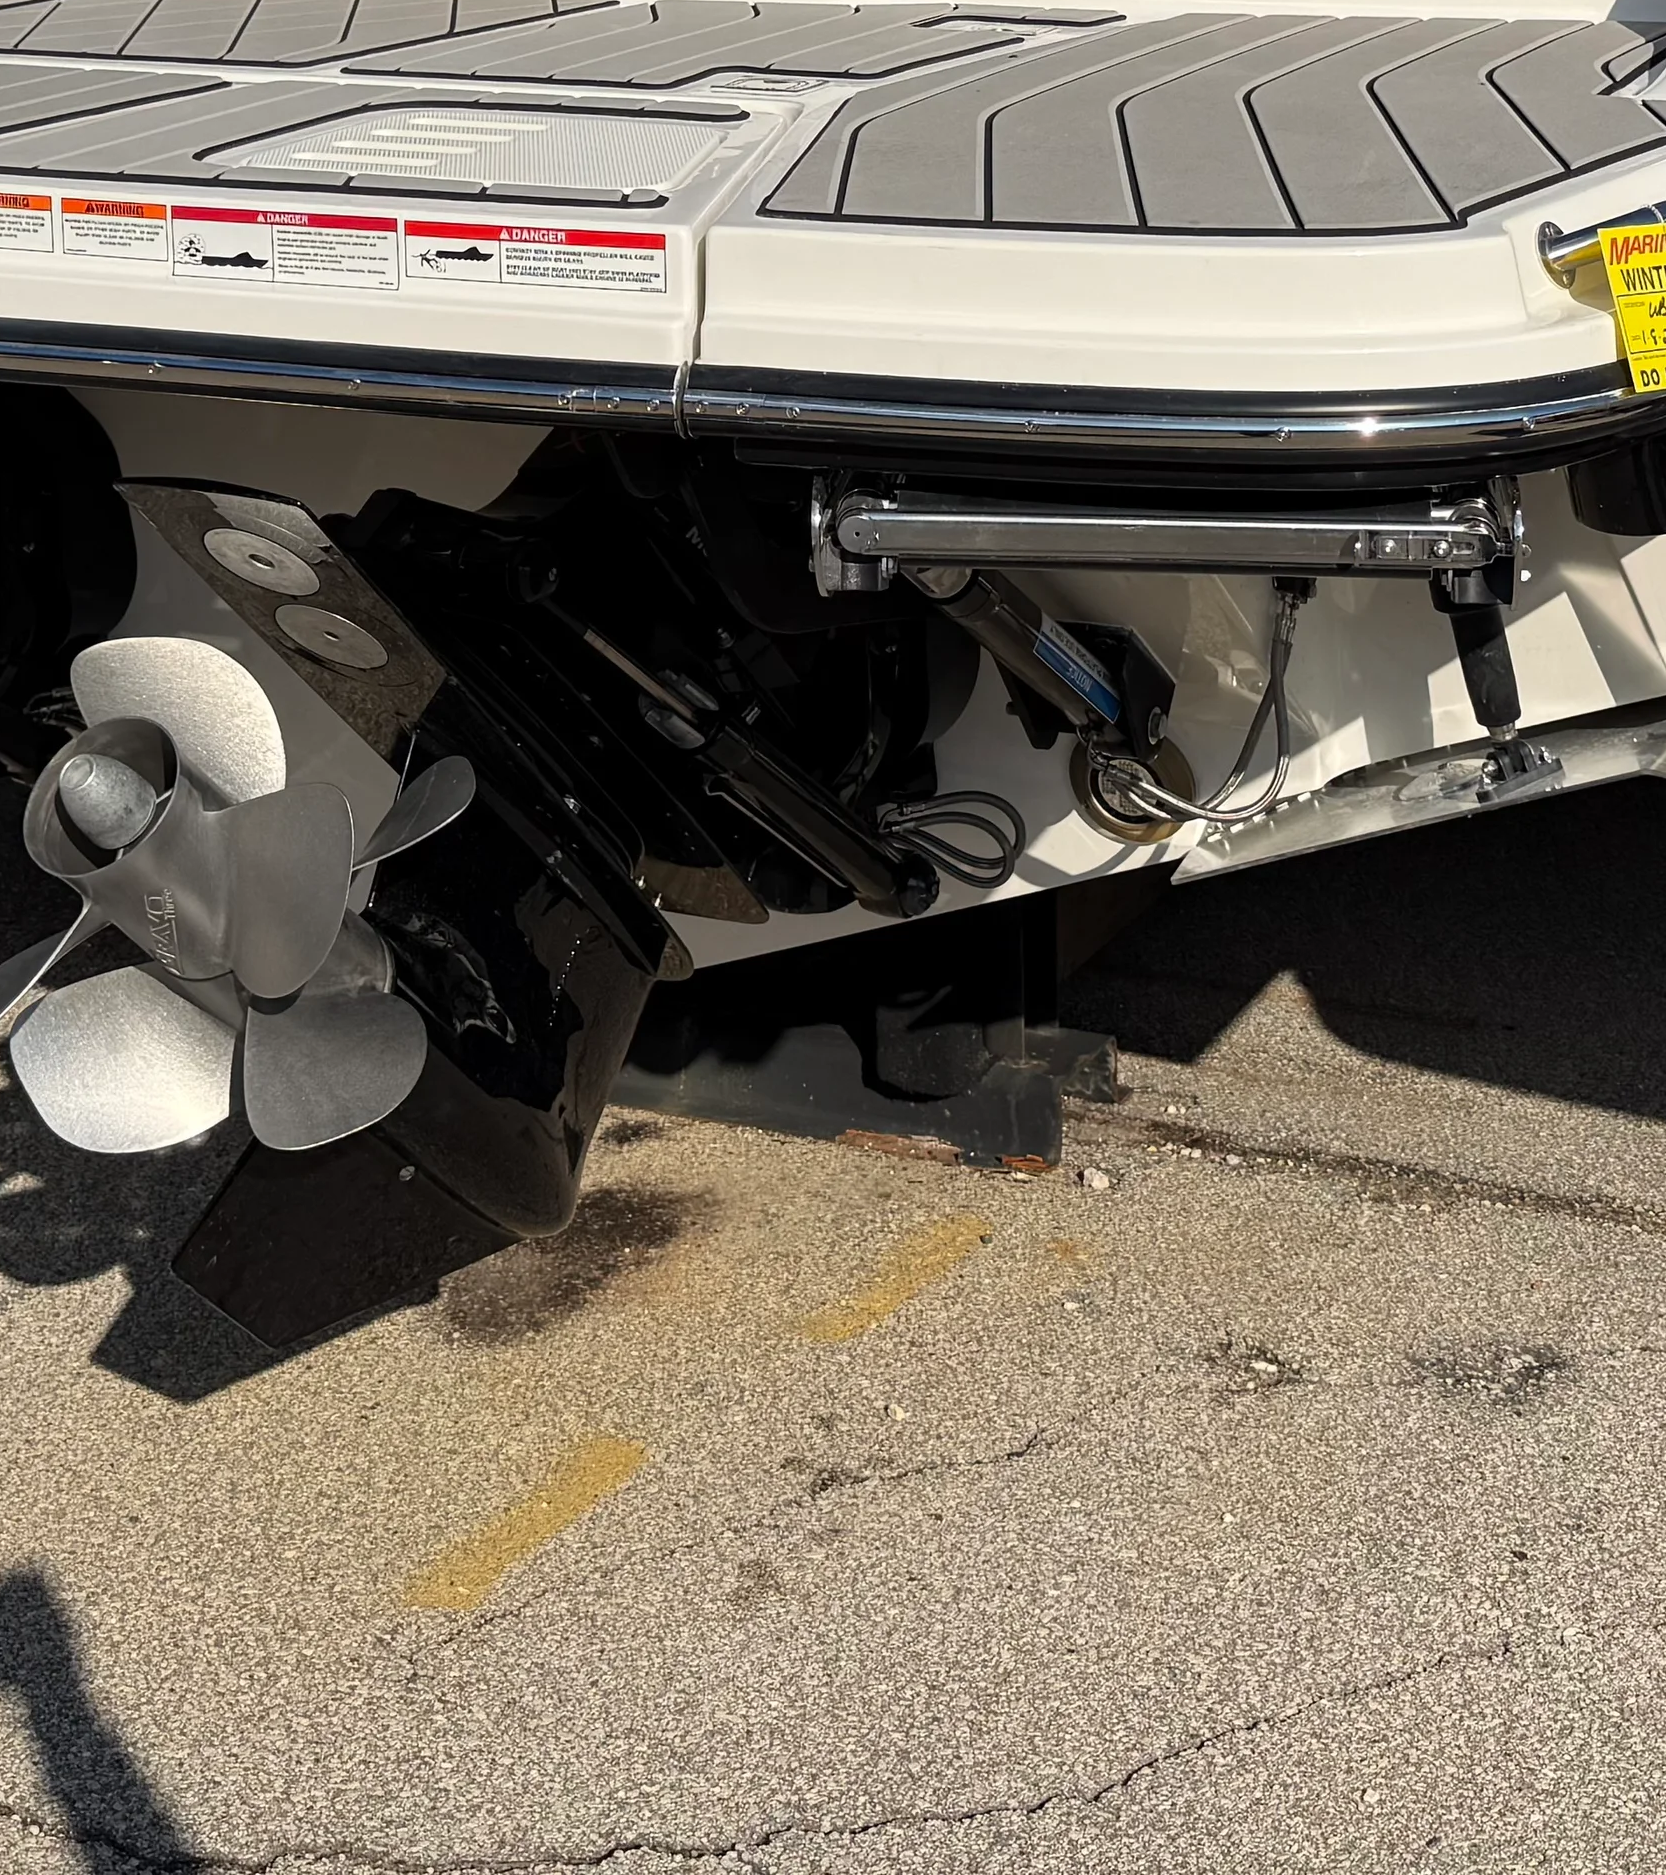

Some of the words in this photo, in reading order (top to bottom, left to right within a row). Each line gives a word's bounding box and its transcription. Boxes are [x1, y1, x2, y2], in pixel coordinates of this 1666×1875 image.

[93, 202, 145, 218] WARNING
[266, 212, 309, 226] DANGER
[511, 229, 567, 244] DANGER
[1640, 368, 1660, 388] DO
